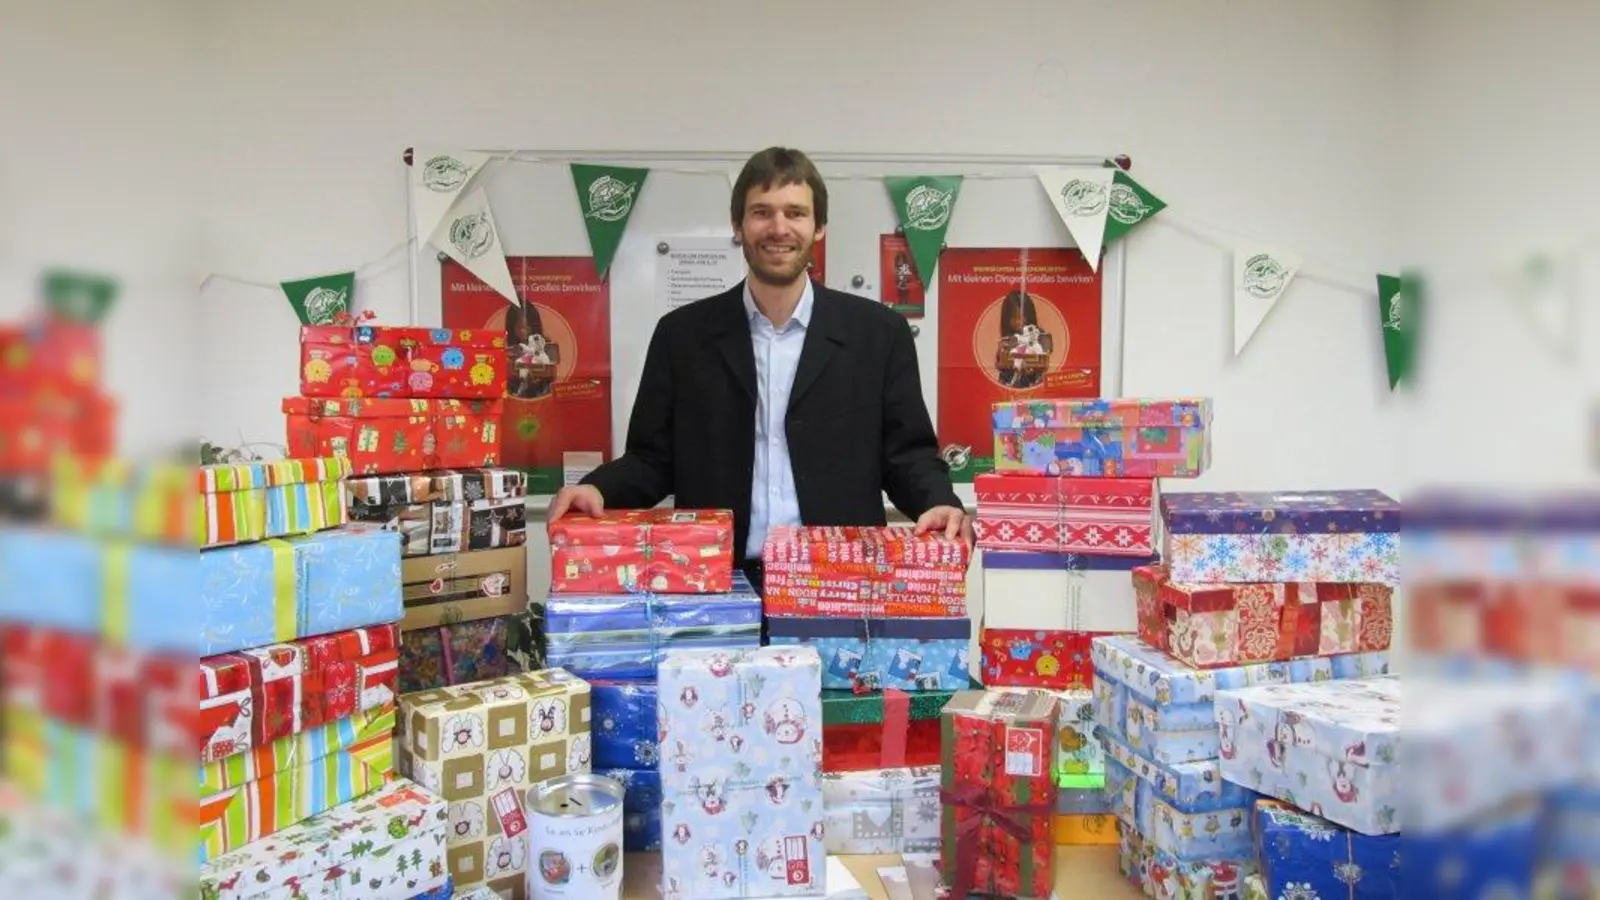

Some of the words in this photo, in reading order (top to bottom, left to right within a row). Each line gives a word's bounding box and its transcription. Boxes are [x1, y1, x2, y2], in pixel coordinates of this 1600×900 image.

[947, 274, 961, 283] Mit
[963, 274, 994, 283] kleinen
[1058, 274, 1094, 283] bewirken
[562, 283, 601, 292] bewirken
